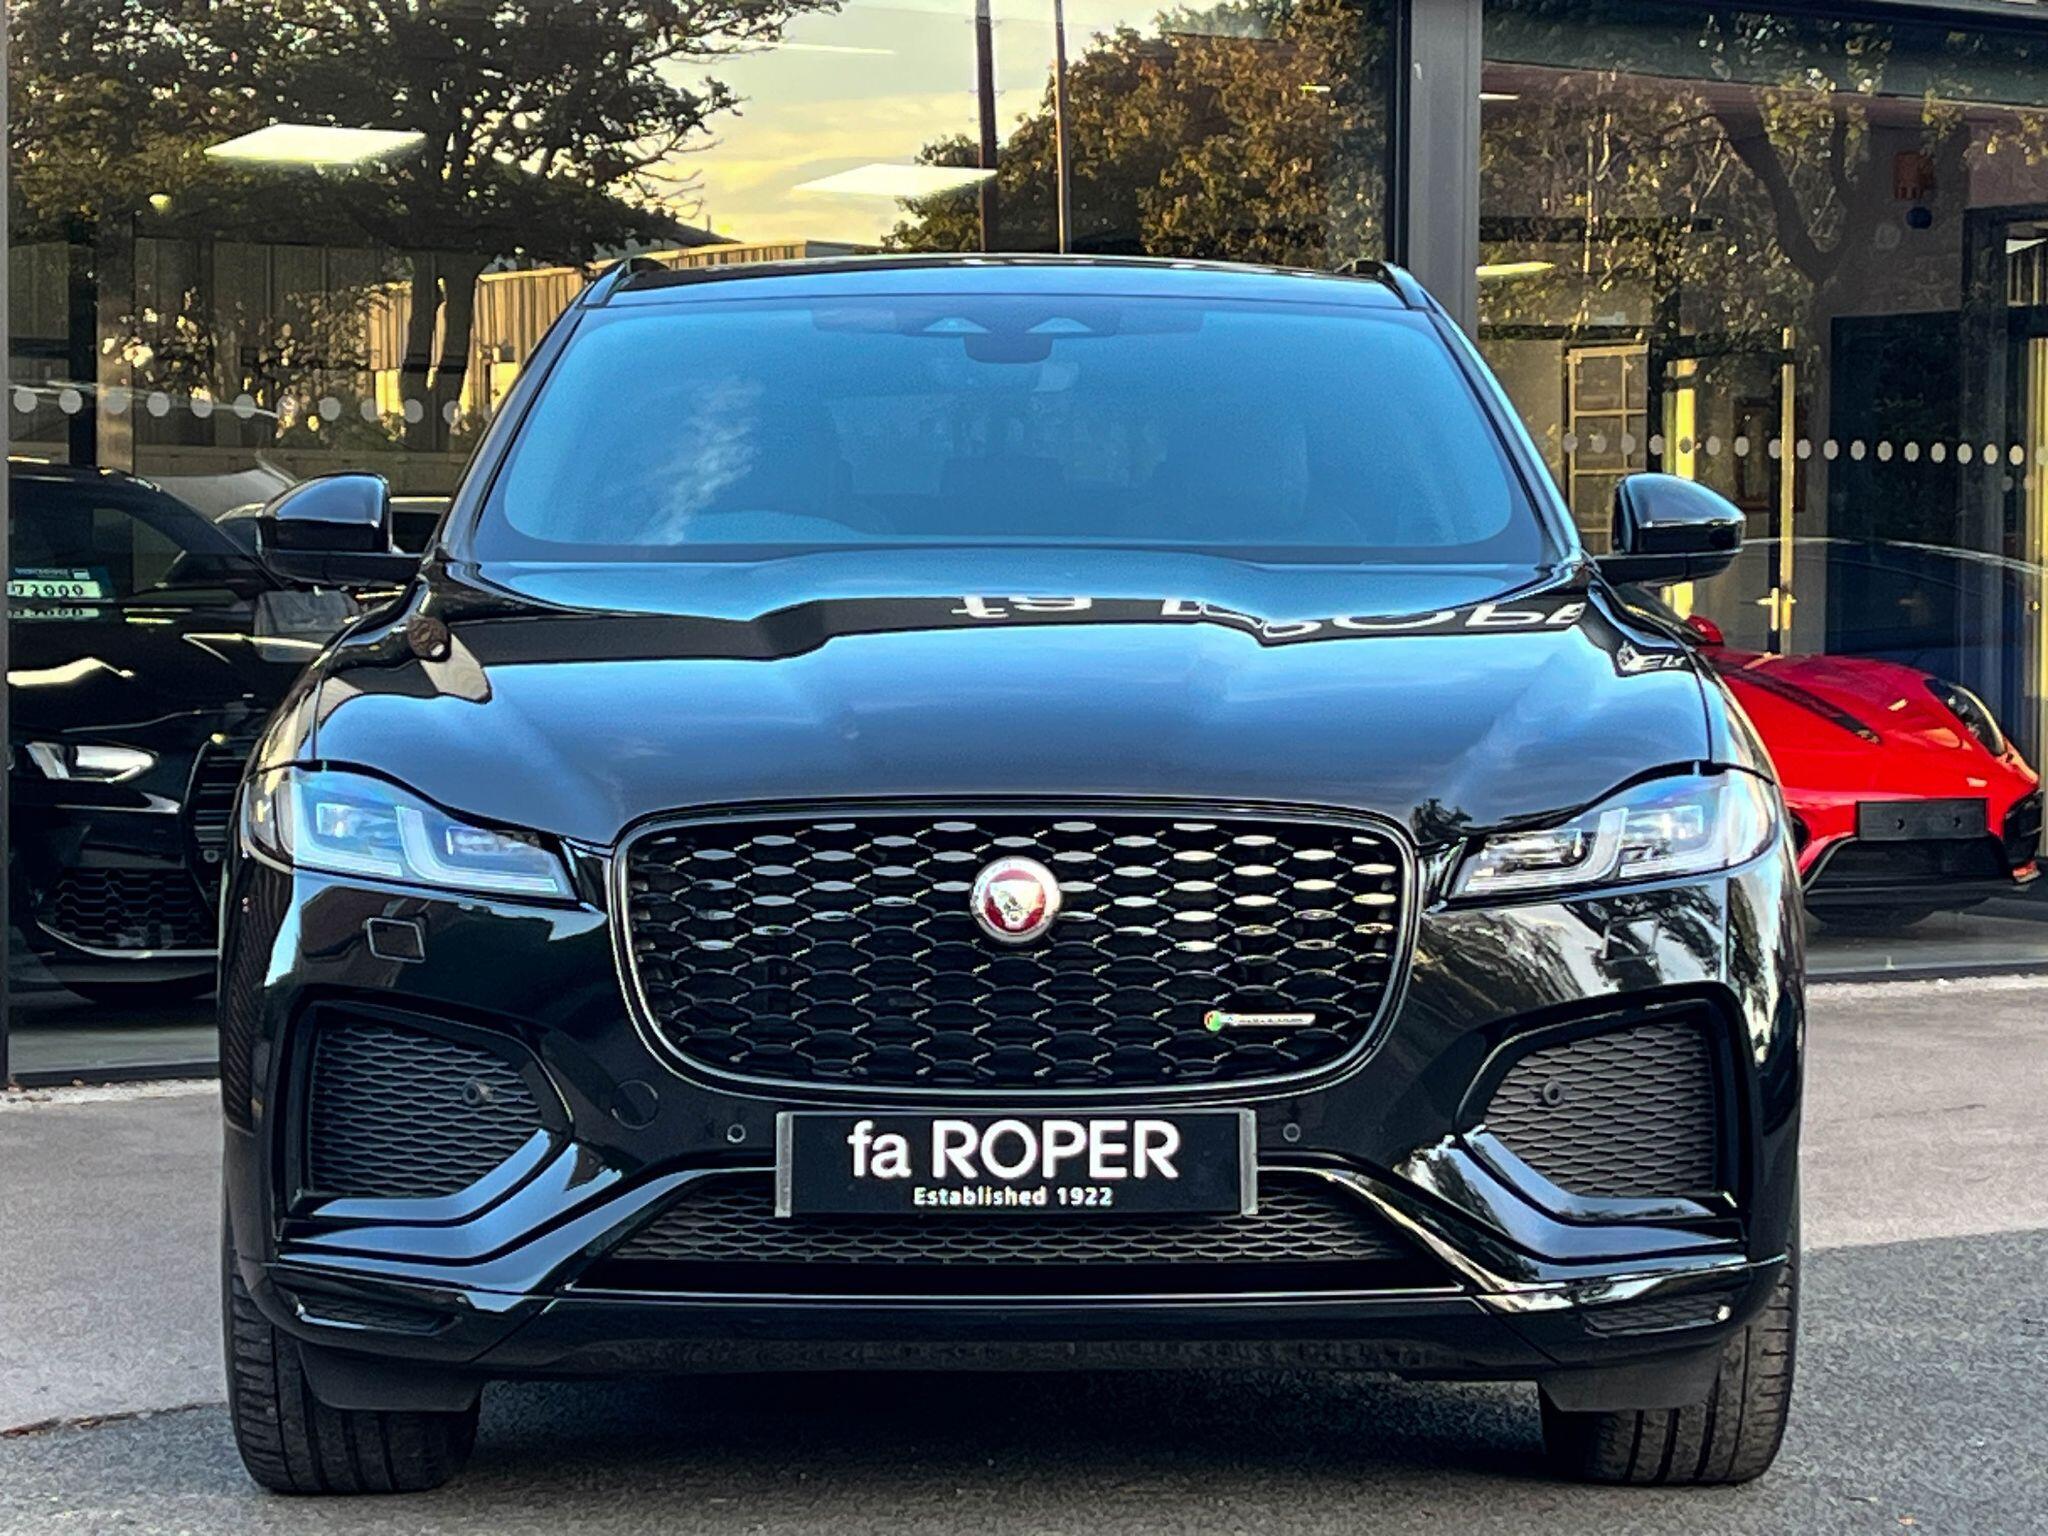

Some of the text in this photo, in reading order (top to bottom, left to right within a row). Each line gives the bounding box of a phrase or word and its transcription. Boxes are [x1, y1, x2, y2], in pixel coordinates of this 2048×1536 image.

[847, 1119, 1181, 1179] fa ROPER
[913, 1186, 1114, 1206] Established 1922
